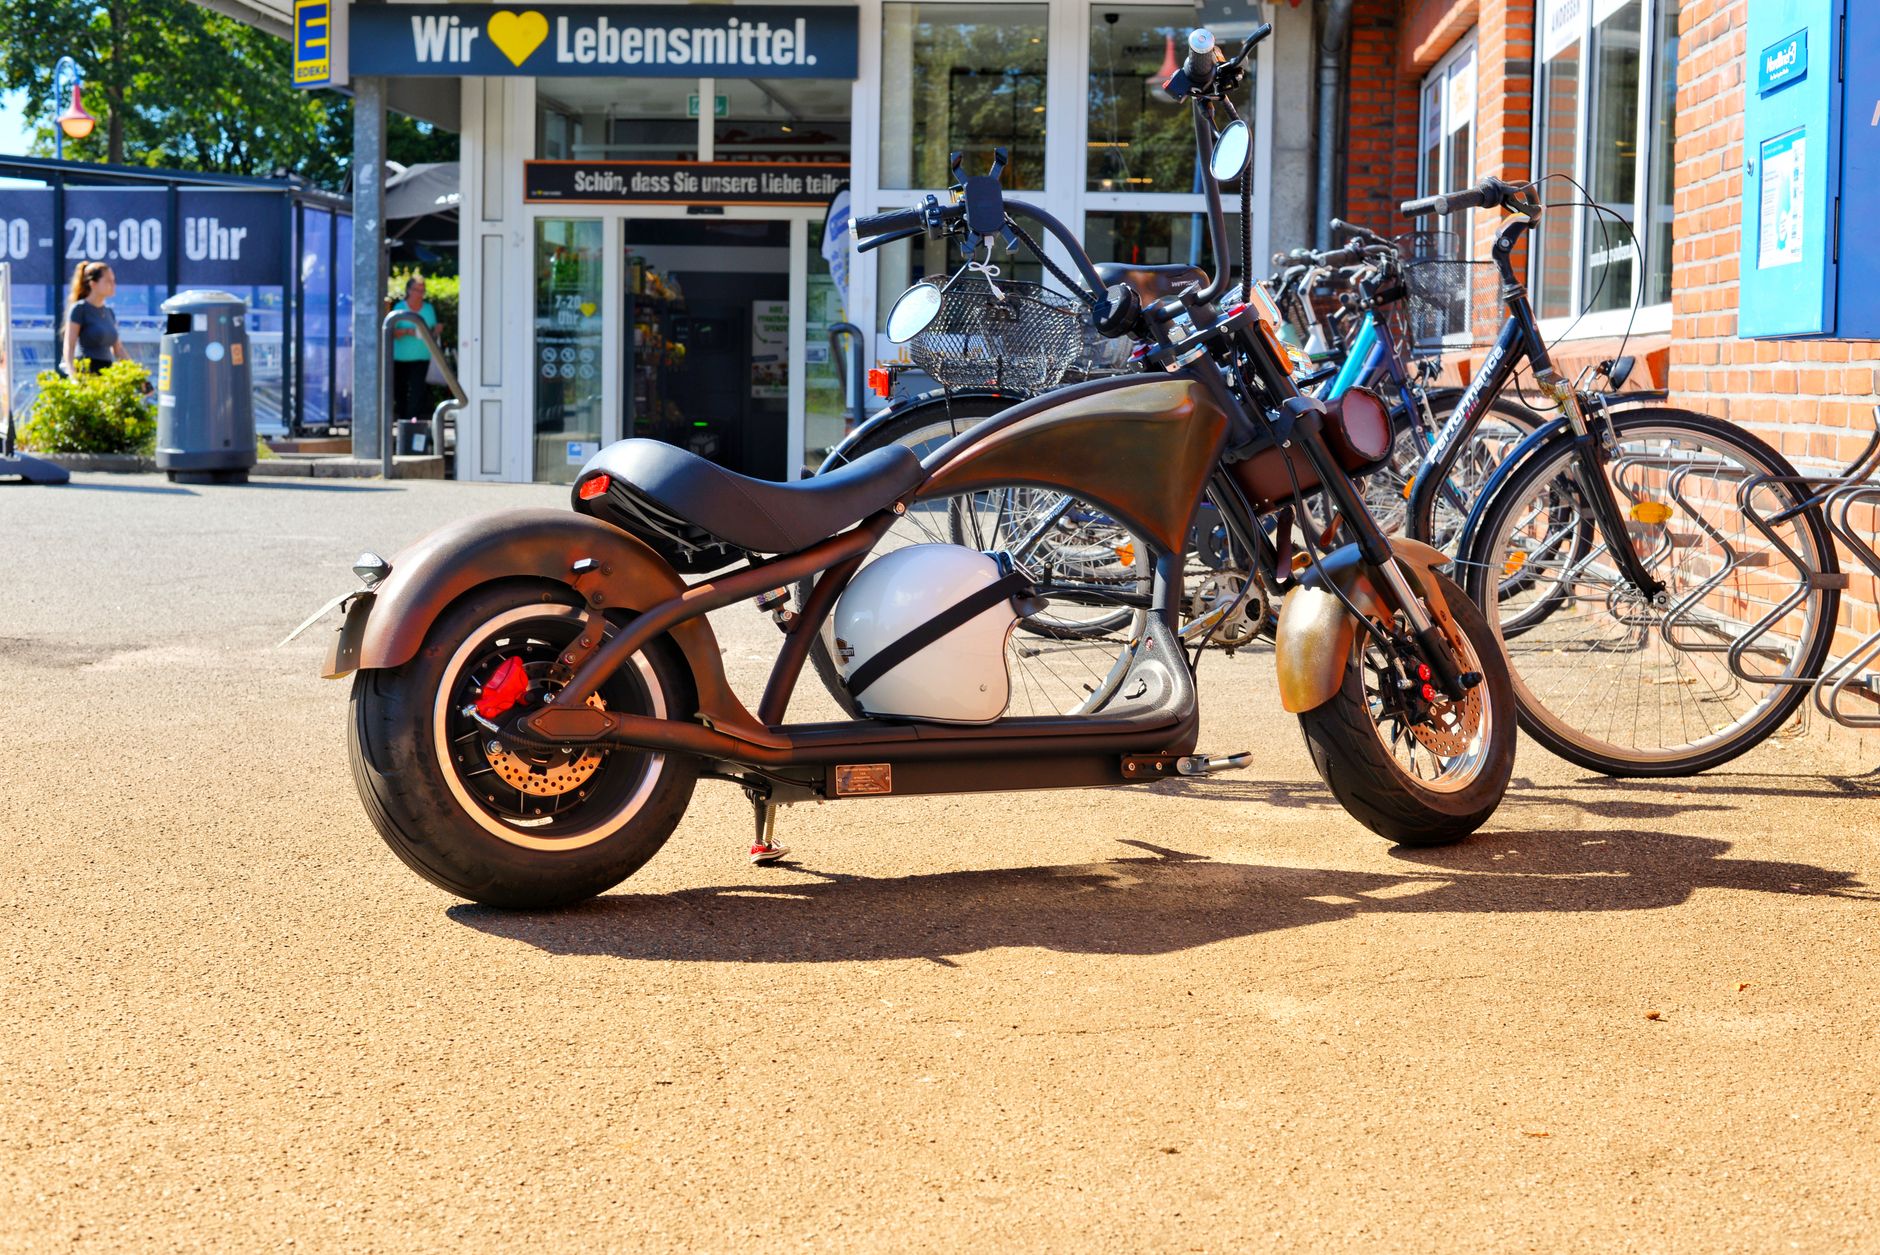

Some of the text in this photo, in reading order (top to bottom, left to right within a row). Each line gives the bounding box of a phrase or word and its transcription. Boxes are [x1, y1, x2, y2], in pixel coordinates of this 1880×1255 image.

[411, 16, 817, 65] Wir Lebensmittel.
[298, 65, 327, 78] EDEKA
[574, 170, 627, 195] Schön,
[632, 173, 670, 192] dass
[673, 171, 698, 193] Sie
[702, 175, 757, 193] unsere
[761, 173, 802, 193] Liebe
[65, 217, 162, 261] 20:00
[185, 217, 247, 261] Uhr
[558, 310, 579, 325] Uhr
[1427, 345, 1504, 464] Performance
